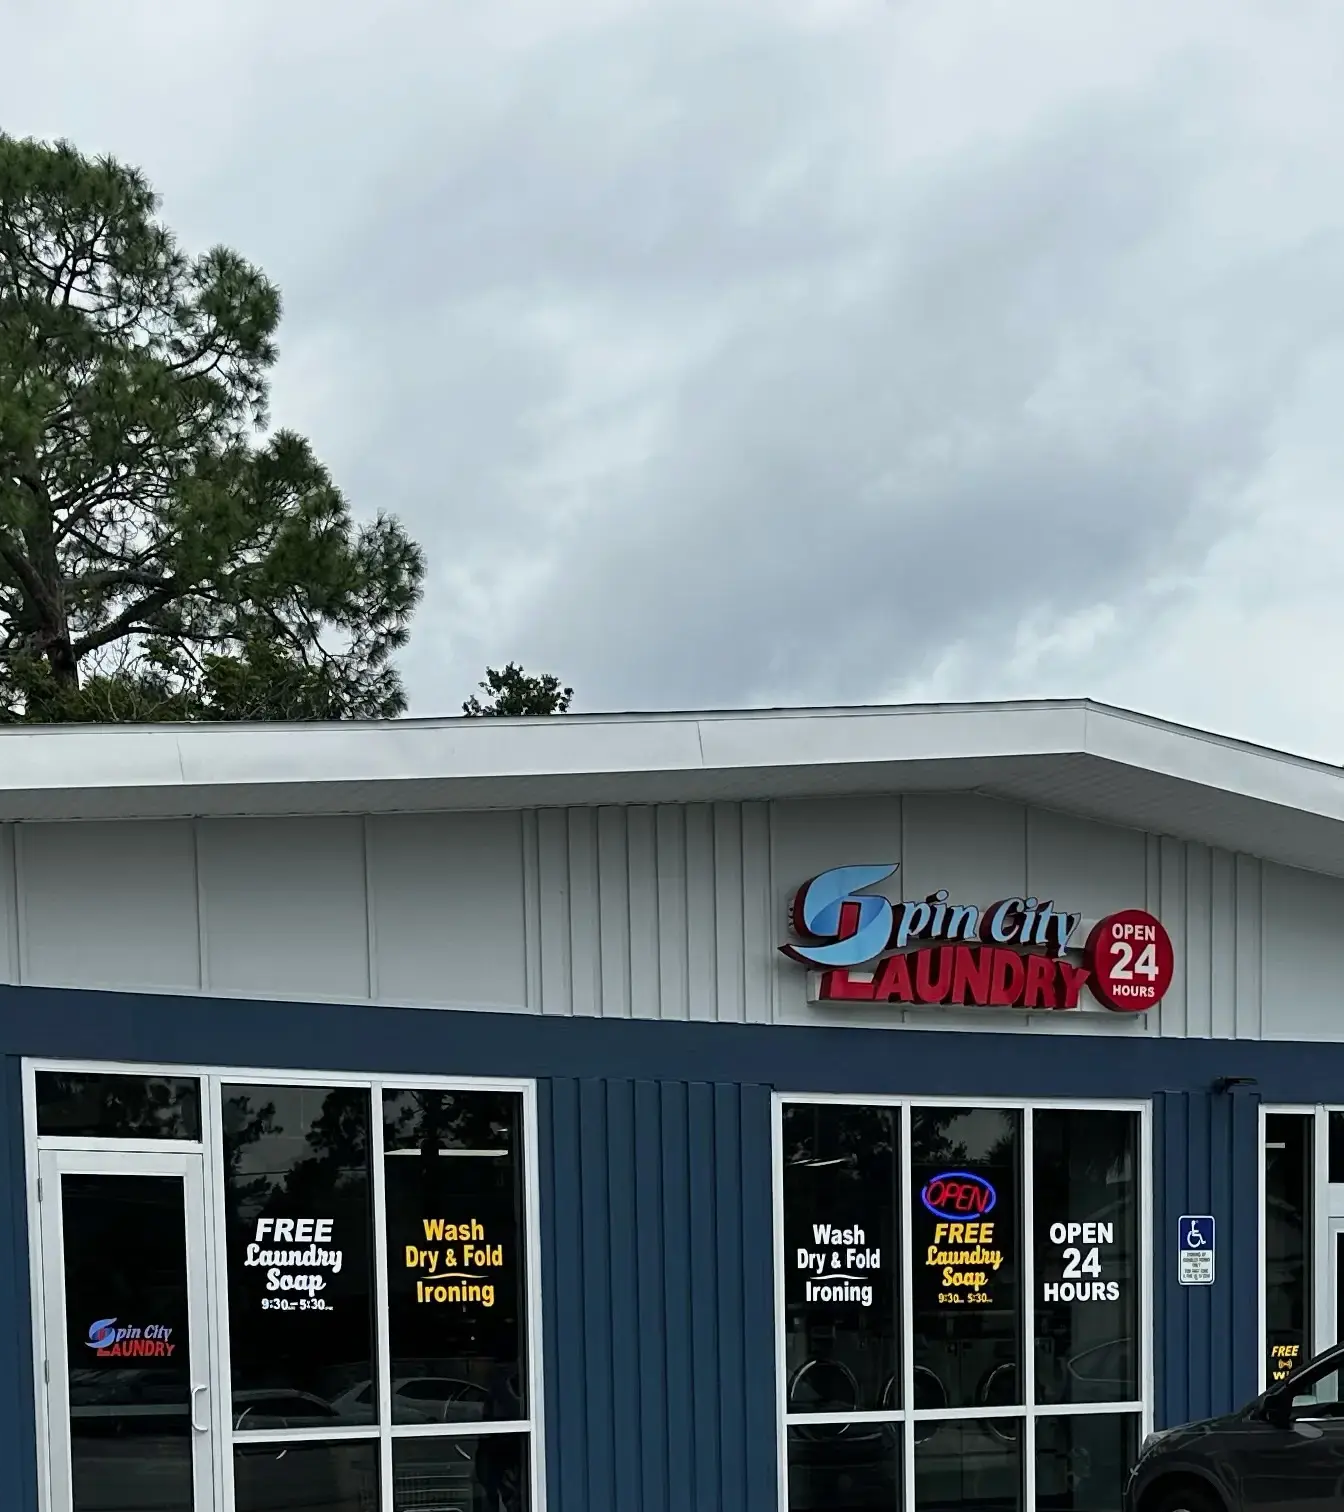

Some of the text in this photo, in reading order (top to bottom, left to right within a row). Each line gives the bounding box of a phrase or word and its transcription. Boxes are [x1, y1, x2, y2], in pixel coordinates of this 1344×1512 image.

[982, 896, 1082, 957] City
[1112, 923, 1156, 941] OPEN
[1110, 942, 1158, 981] 24
[820, 946, 1090, 1009] LAUNDRY
[1112, 984, 1155, 998] HOURS
[926, 1182, 989, 1213] OPEN
[255, 1218, 334, 1242] FREE
[423, 1219, 484, 1240] Wash
[813, 1224, 864, 1245] Wash
[934, 1223, 994, 1244] FREE
[1050, 1223, 1113, 1244] OPEN
[245, 1244, 342, 1273] Laundry
[406, 1244, 503, 1273] Dry & Fold
[798, 1248, 880, 1274] Dry & Fold
[926, 1245, 1003, 1270] Laundry
[1063, 1248, 1101, 1278] 24
[266, 1268, 326, 1297] Soap
[942, 1267, 988, 1291] Soap
[417, 1280, 494, 1307] Ironing
[806, 1281, 872, 1307] Ironing
[1044, 1282, 1119, 1301] HOURS
[144, 1324, 172, 1342] City
[97, 1340, 176, 1356] LAUNDRY
[1271, 1345, 1299, 1357] FREE
